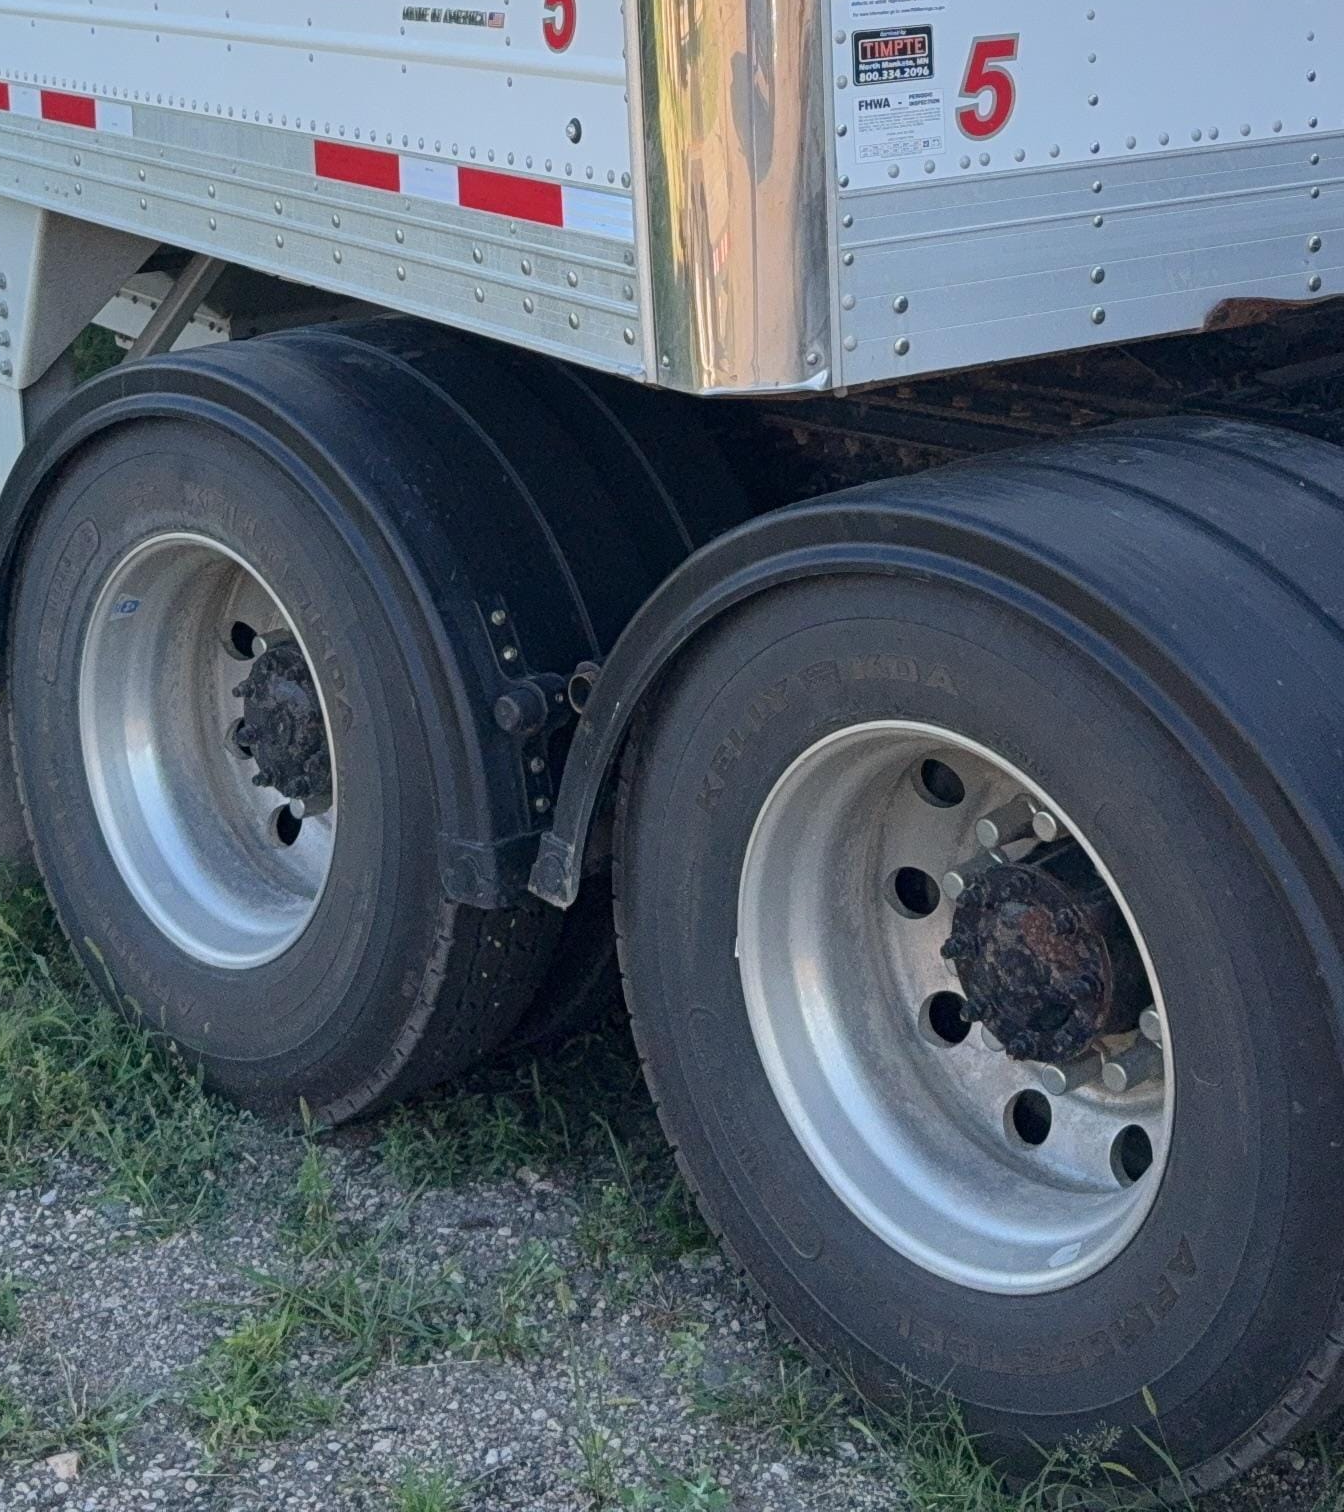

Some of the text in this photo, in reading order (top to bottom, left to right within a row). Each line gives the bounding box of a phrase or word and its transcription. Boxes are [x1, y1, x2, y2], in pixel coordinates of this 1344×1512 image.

[863, 37, 925, 59] TIMPTE
[859, 66, 930, 83] 800.334.2096
[955, 32, 1020, 142] 5
[858, 97, 891, 111] FHWA
